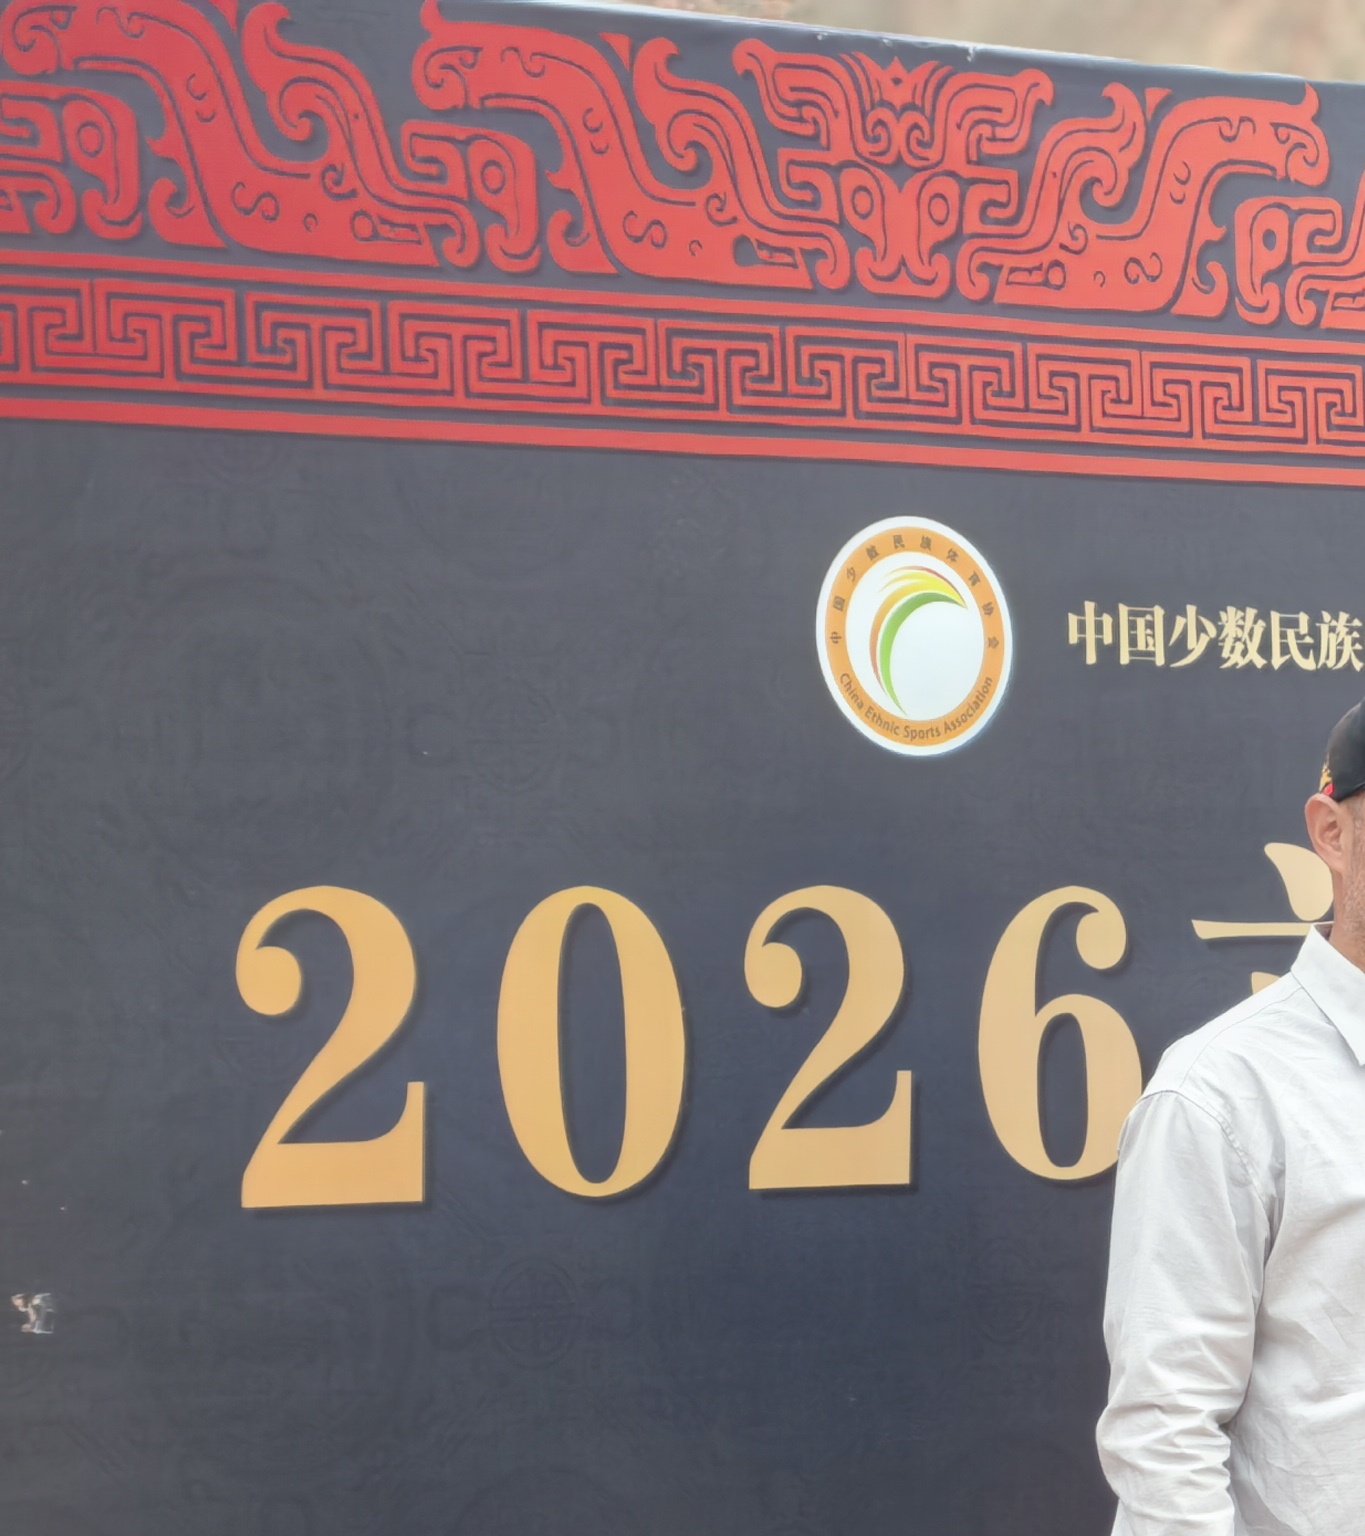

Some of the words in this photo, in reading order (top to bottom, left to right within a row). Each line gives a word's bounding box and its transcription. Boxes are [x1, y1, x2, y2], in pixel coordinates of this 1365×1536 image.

[840, 673, 864, 710] China
[864, 706, 900, 736] Ethnic
[902, 726, 941, 742] Sports
[943, 676, 993, 733] Association
